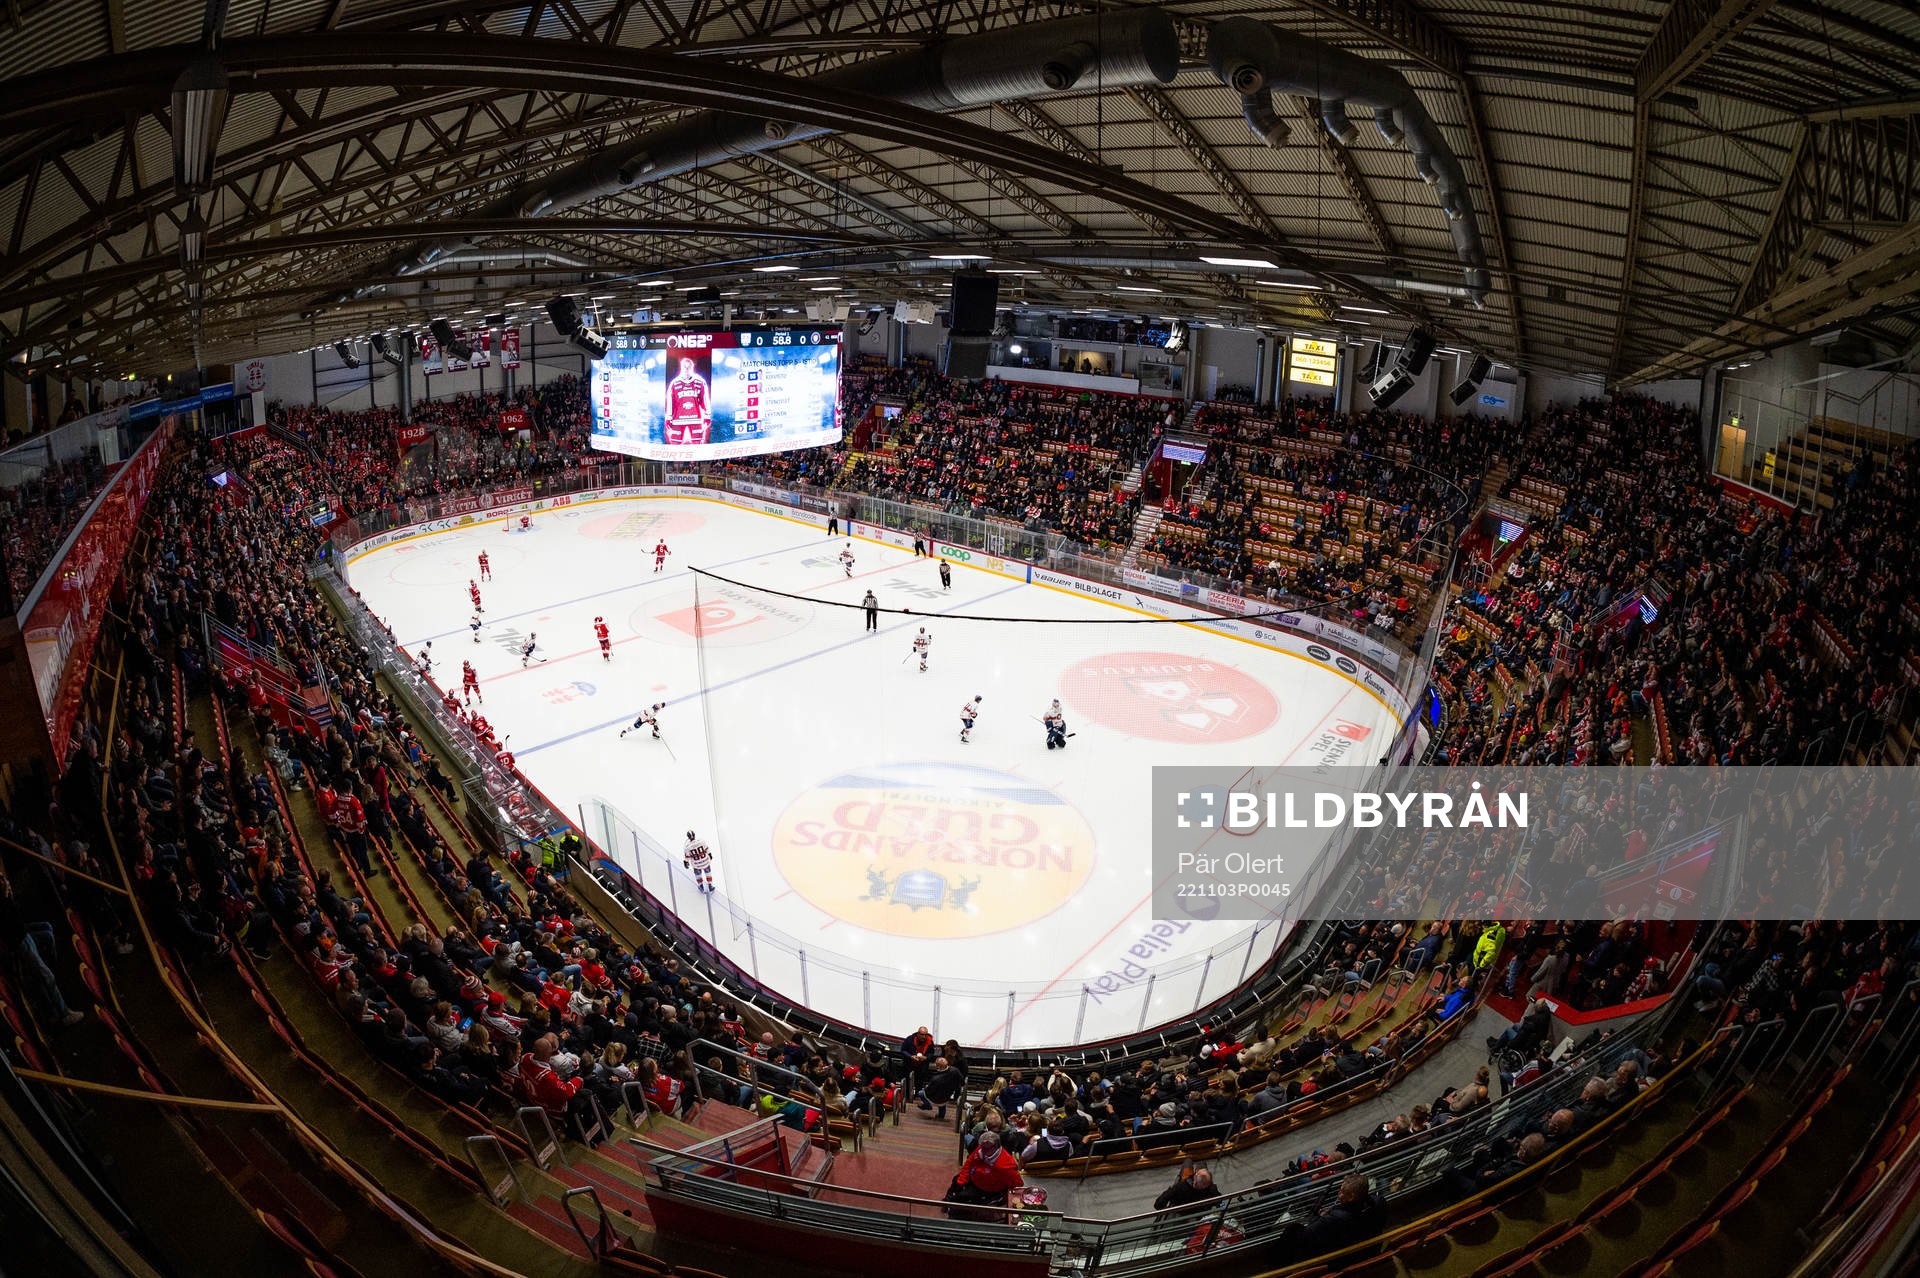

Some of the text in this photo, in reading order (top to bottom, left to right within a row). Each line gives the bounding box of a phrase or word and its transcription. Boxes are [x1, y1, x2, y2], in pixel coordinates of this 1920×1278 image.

[402, 428, 425, 439] 1928
[553, 496, 571, 507] ABB
[941, 546, 971, 562] coop
[1075, 582, 1122, 600] BILBOLAGET
[1208, 592, 1246, 606] PIZZERIA
[1085, 916, 1190, 1004] Telia Play
